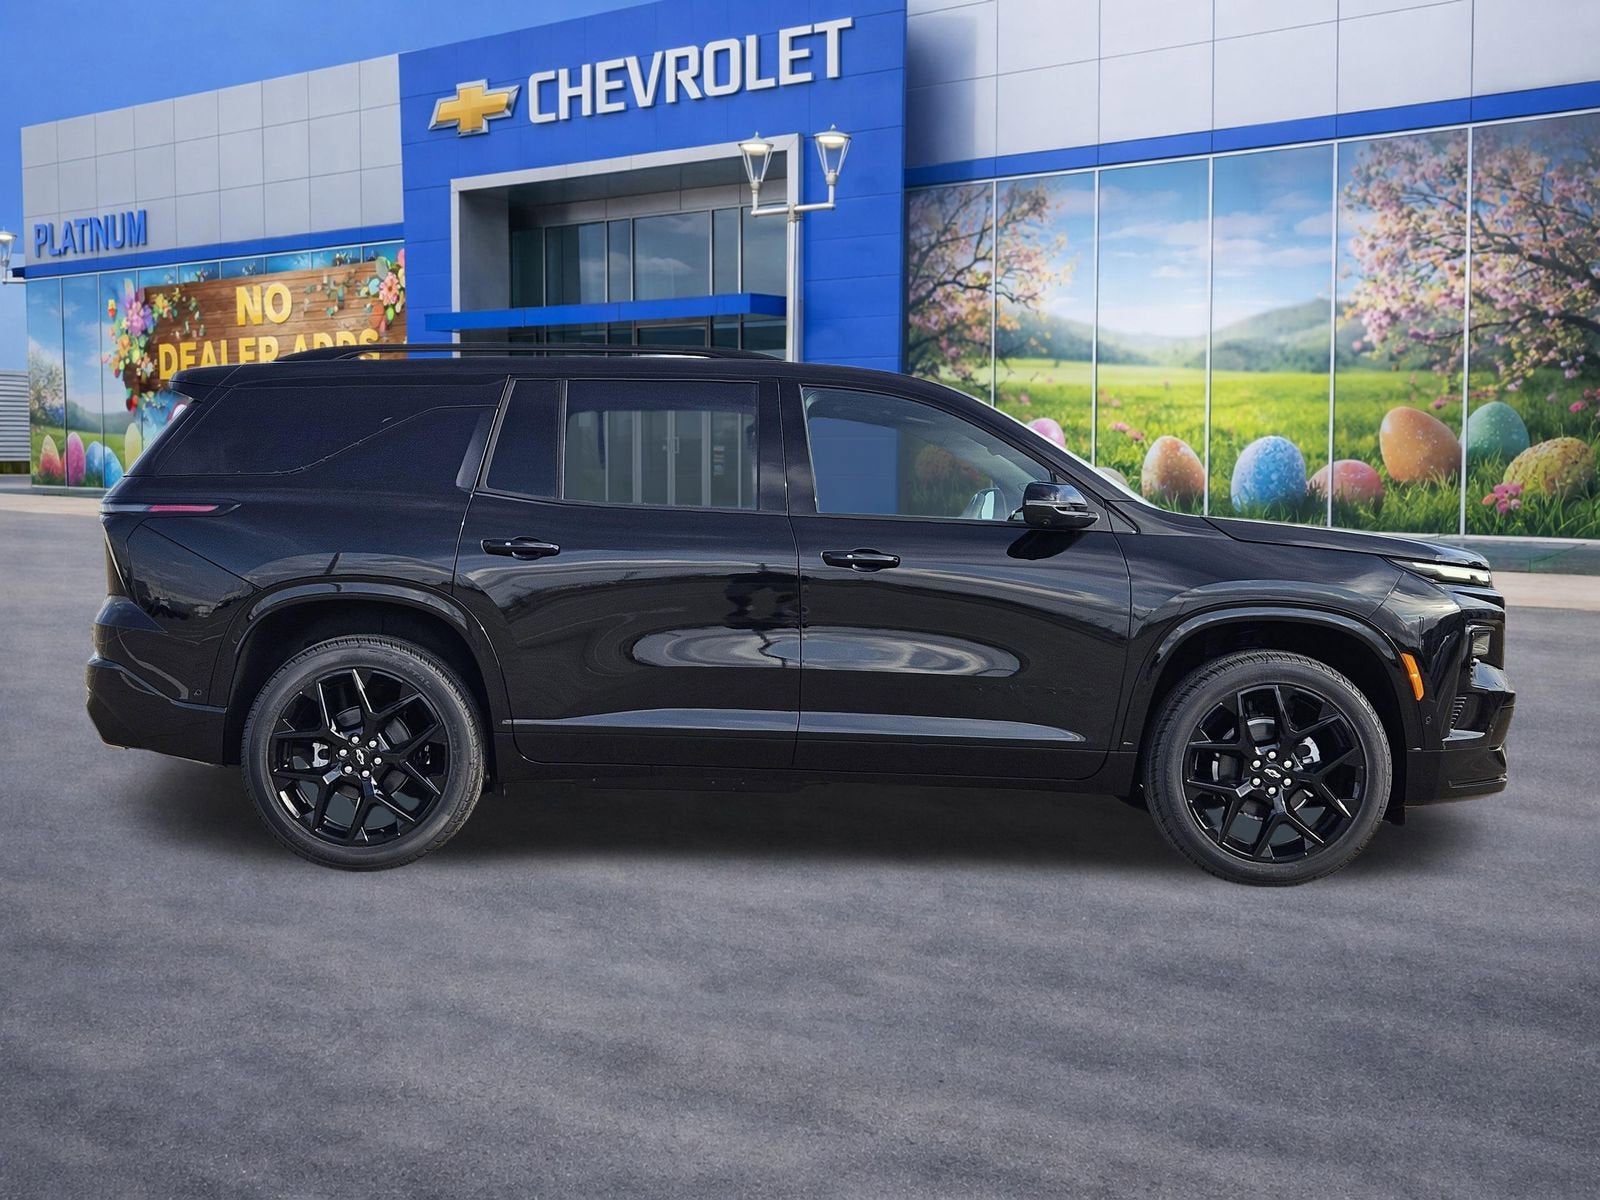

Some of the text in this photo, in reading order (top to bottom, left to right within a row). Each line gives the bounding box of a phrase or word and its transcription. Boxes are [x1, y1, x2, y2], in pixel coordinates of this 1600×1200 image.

[528, 16, 854, 124] CHEVROLET
[34, 209, 147, 258] PLATINUM
[235, 283, 292, 326] NO
[159, 336, 279, 380] DEALER
